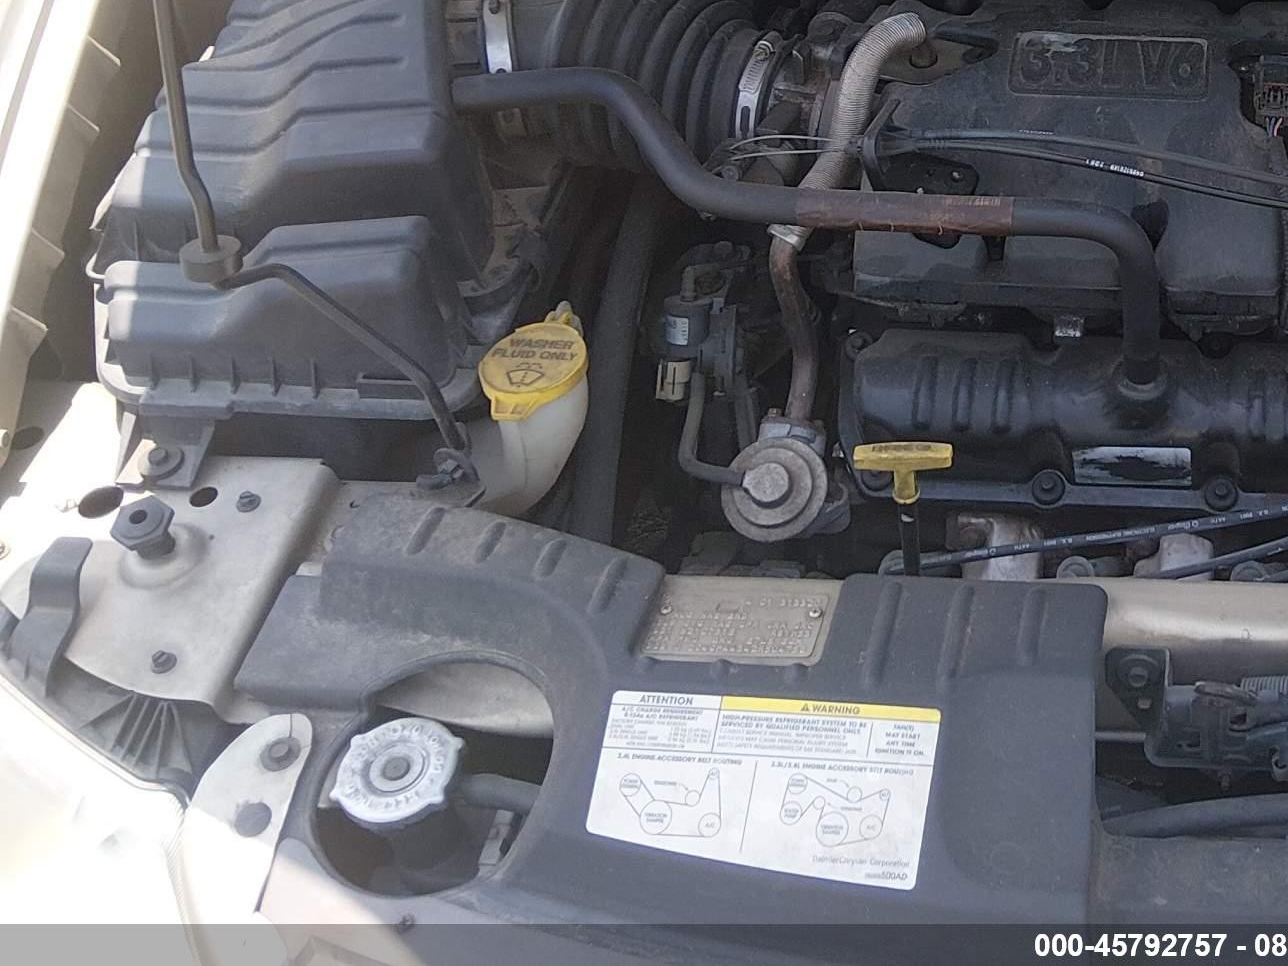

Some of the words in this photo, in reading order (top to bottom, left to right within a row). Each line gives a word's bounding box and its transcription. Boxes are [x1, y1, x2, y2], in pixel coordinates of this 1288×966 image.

[509, 338, 575, 350] WASHER
[492, 348, 535, 359] FLUID
[539, 350, 578, 361] ONLY
[640, 695, 693, 705] ATTENTION
[812, 704, 860, 715] WARNING
[722, 714, 774, 722] HIGH-PRESSURE
[775, 717, 820, 725] REFRIGERANT
[766, 723, 800, 731] QUALIFIED
[657, 755, 696, 763] ACCESSORY
[828, 765, 868, 773] ACCESSORY
[884, 768, 914, 776] ROUTING
[812, 855, 867, 865] DaimlerChrysler
[870, 858, 910, 867] Corporation
